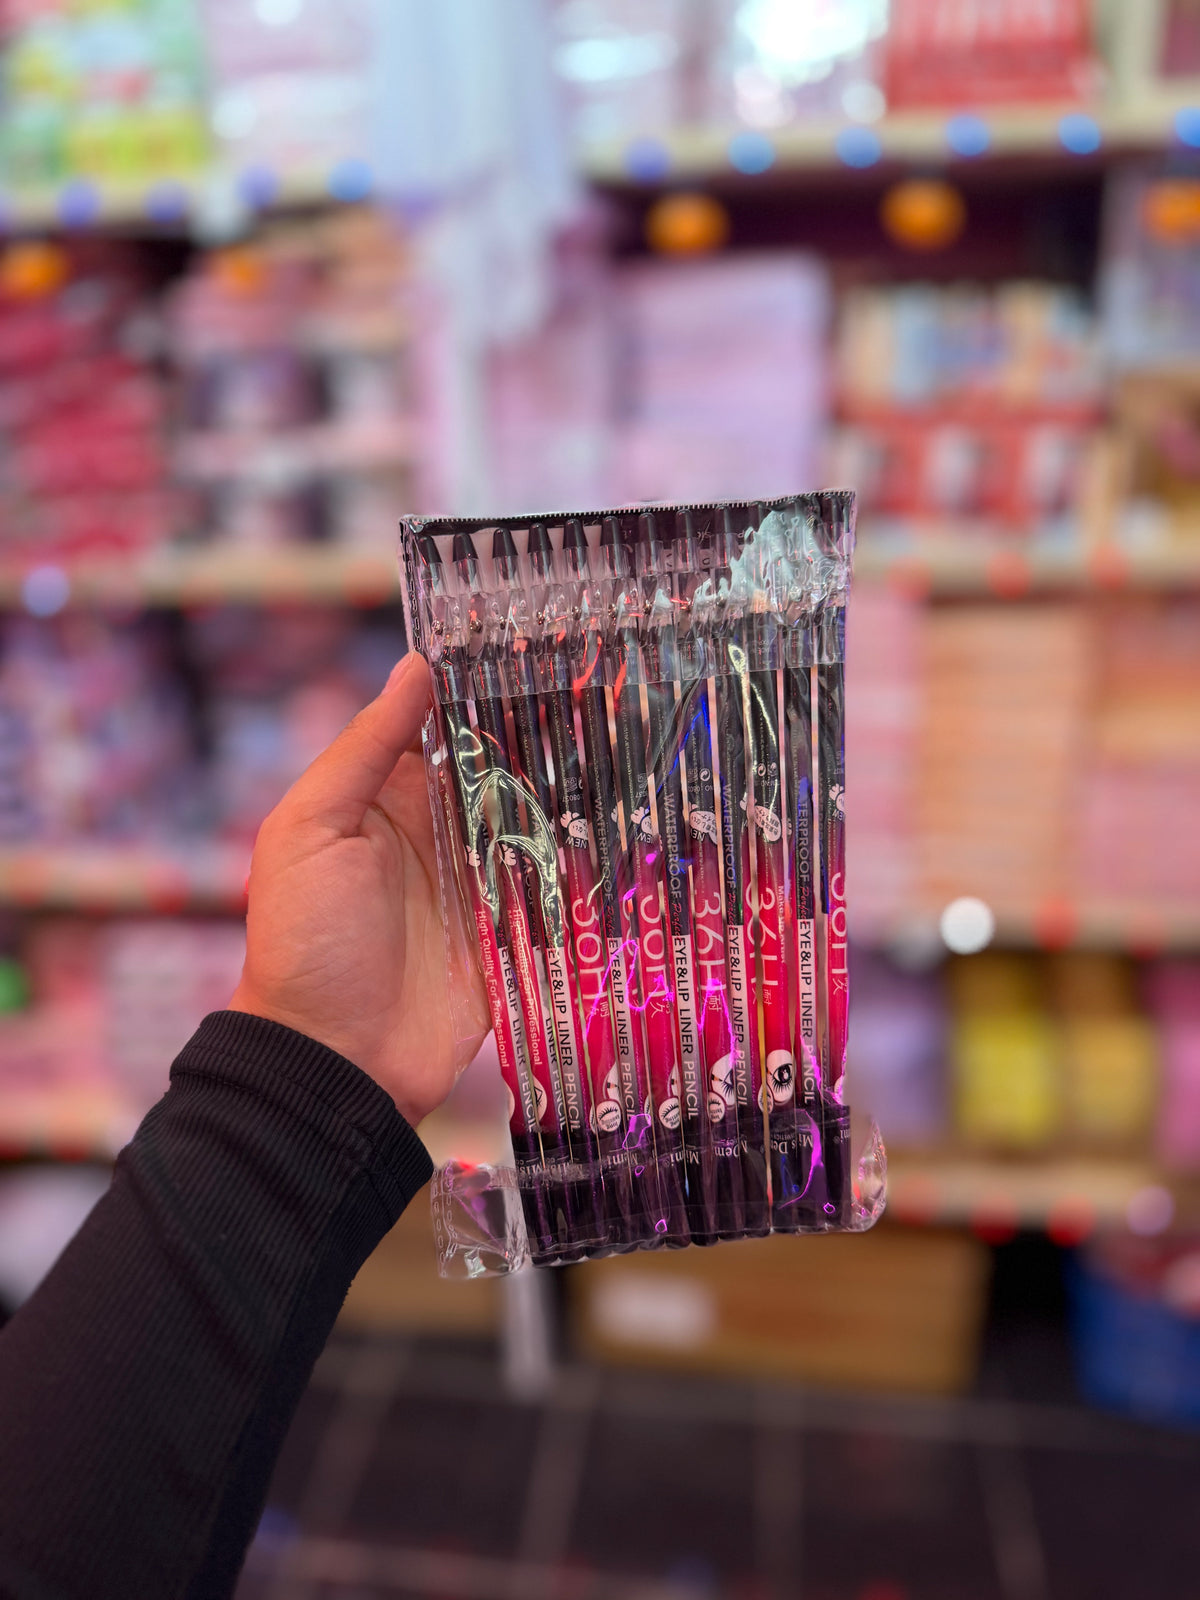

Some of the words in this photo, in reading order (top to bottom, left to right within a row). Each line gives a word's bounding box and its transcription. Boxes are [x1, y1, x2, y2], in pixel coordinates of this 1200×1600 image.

[565, 836, 588, 849] NEW
[594, 796, 614, 902] WATERPROOF
[664, 792, 682, 900] WATERPROOF
[690, 828, 705, 842] NE
[800, 802, 810, 885] TERPROOF
[477, 910, 489, 937] High
[695, 891, 727, 991] 36H
[799, 920, 812, 986] EYE&LIP
[482, 936, 495, 977] Quality
[488, 977, 498, 996] For
[547, 951, 567, 1015] EYE&LIP
[608, 938, 625, 1004] EYE&LIP
[673, 937, 689, 1002] EYE&LIP
[728, 927, 742, 992] EYE&LIP
[491, 998, 510, 1069] Professional
[500, 946, 519, 1013] EYE&LIP
[512, 1018, 527, 1067] LINER
[520, 1071, 537, 1133] PENCIL
[525, 997, 543, 1066] Professional
[557, 1020, 573, 1067] LINER
[616, 1009, 630, 1056] LINER
[679, 1008, 694, 1055] LINER
[732, 997, 745, 1044] LINER
[801, 992, 814, 1038] LINER
[564, 1072, 581, 1132] PENCIL
[620, 1061, 636, 1121] PENCIL
[683, 1060, 699, 1121] PENCIL
[735, 1049, 748, 1107] PENCIL
[803, 1044, 816, 1105] PNCIL
